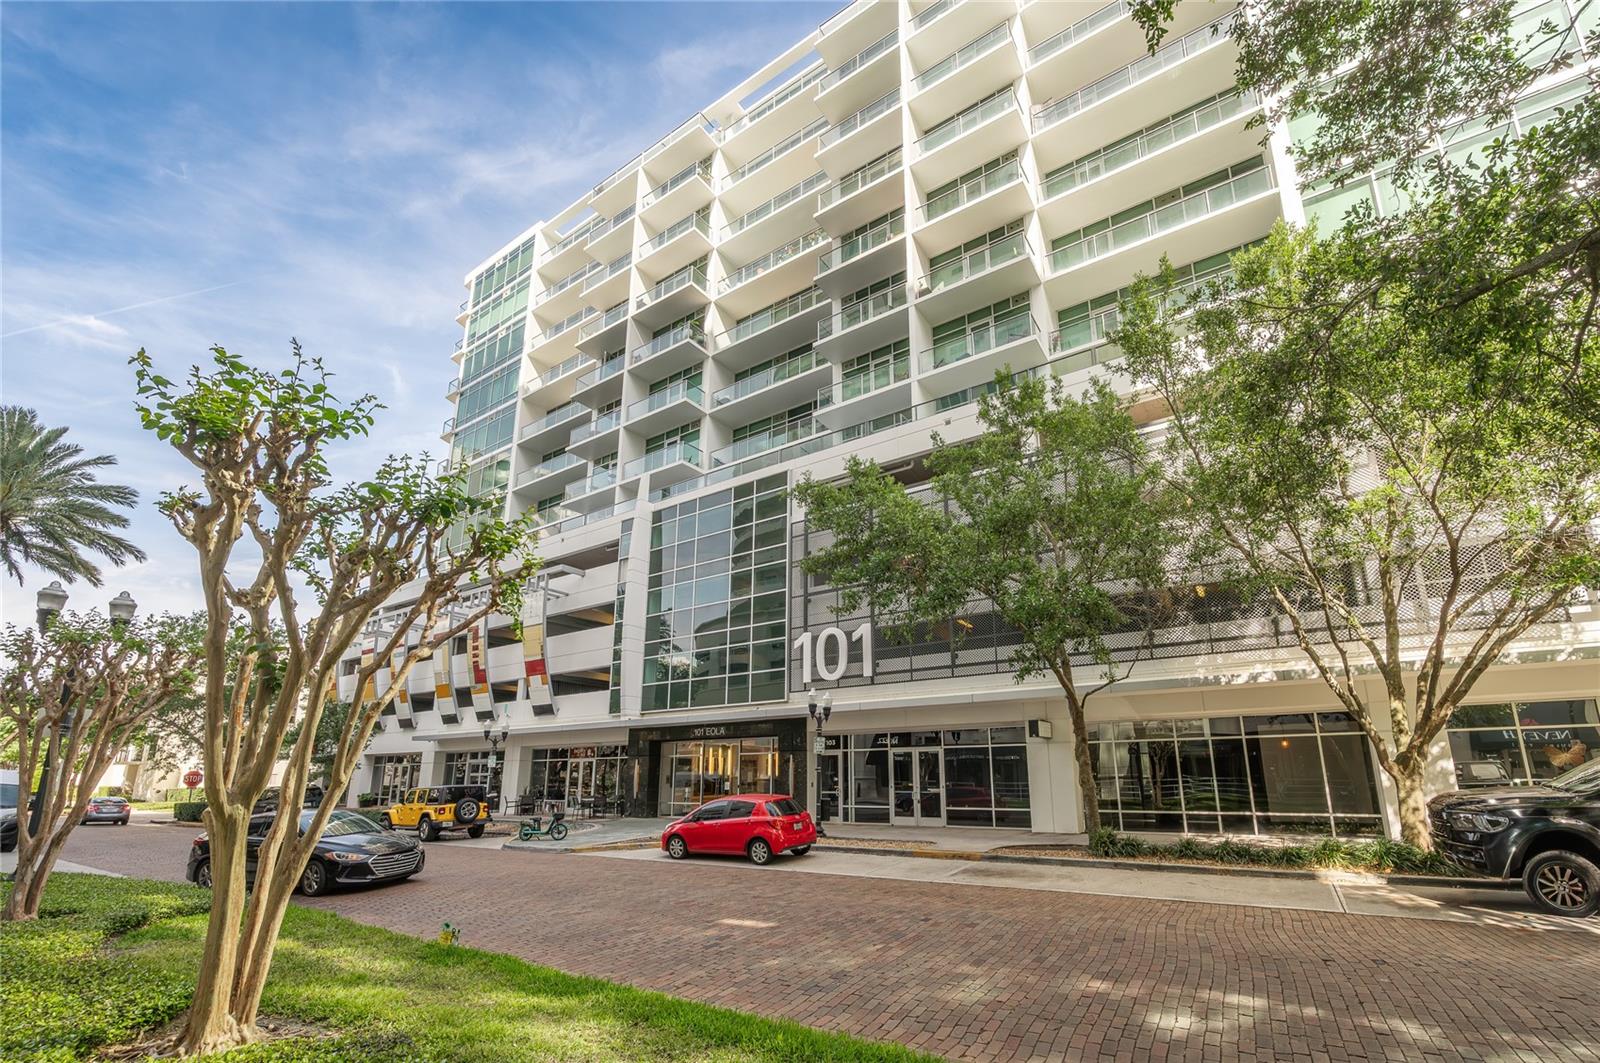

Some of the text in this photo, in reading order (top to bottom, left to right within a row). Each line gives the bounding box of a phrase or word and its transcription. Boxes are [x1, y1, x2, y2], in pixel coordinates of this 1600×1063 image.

[794, 623, 872, 683] 101
[694, 727, 726, 736] 101 EOLA
